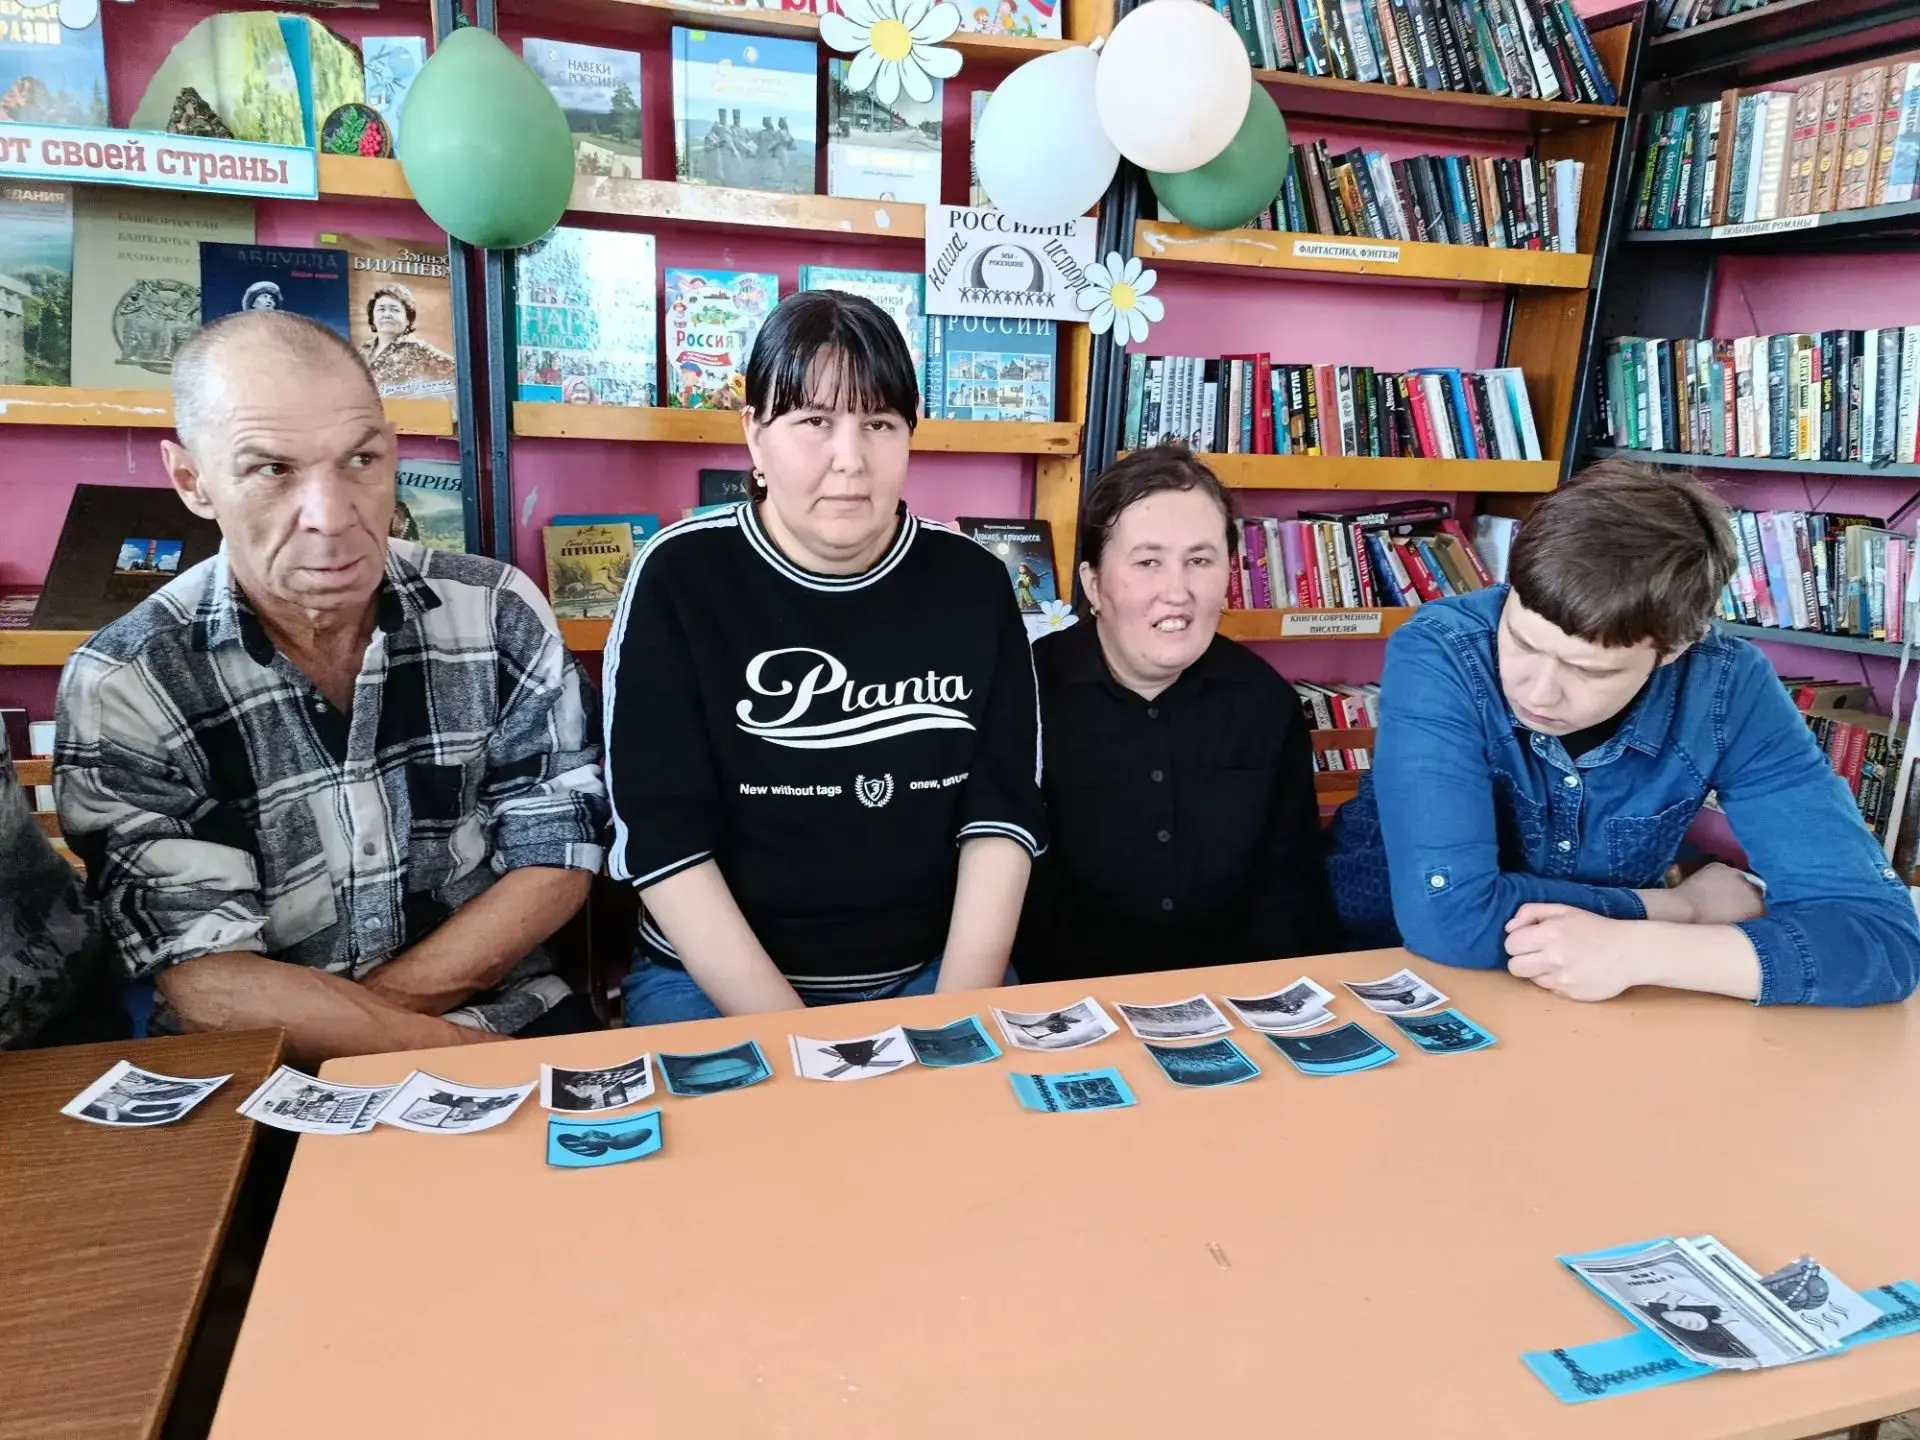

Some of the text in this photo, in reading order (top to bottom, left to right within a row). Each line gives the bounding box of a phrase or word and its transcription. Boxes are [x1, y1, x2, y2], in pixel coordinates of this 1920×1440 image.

[567, 59, 612, 75] НАВЕКИ
[568, 72, 623, 88] РОССИЕЙ
[41, 139, 147, 172] своей
[157, 148, 289, 185] страны
[1657, 150, 1676, 215] Джин Вулф
[1771, 219, 1813, 231] РОМАНЫ
[117, 231, 200, 247] БАШКОРТОС
[1299, 245, 1398, 260] ФАНТАСТИКА, ФЭНТЕЗИ
[947, 315, 1051, 336] РОССИИ
[1290, 370, 1302, 409] ПЕТЛЯ
[1319, 613, 1378, 621] СОВРЕМЕННЫХ
[1310, 624, 1357, 633] ПИСАТЕЛЕЙ
[736, 647, 973, 728] Planta
[739, 784, 768, 795] New
[771, 785, 814, 796] without
[816, 785, 842, 797] tags
[910, 779, 940, 790] onew,
